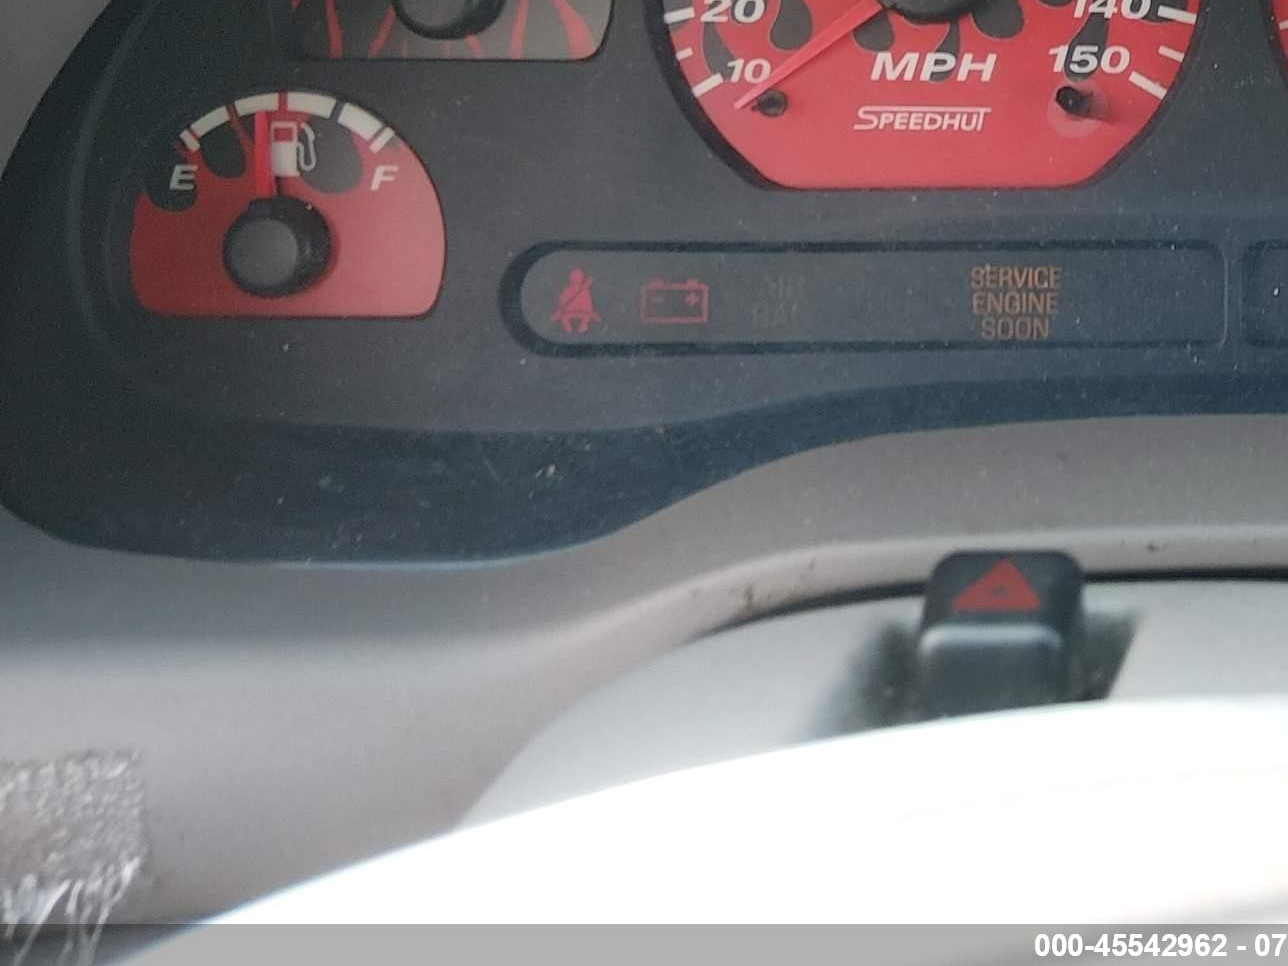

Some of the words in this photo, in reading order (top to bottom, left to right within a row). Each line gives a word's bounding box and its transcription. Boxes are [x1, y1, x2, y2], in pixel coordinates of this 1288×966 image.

[727, 58, 771, 84] 10
[870, 52, 998, 82] MPH
[1048, 45, 1131, 74] 150
[853, 105, 992, 132] SPEEDHUT
[168, 164, 199, 191] E
[370, 164, 399, 191] F
[970, 265, 1062, 289] SERVICE
[971, 291, 1060, 315] ENGINE
[981, 316, 1050, 340] SOON
